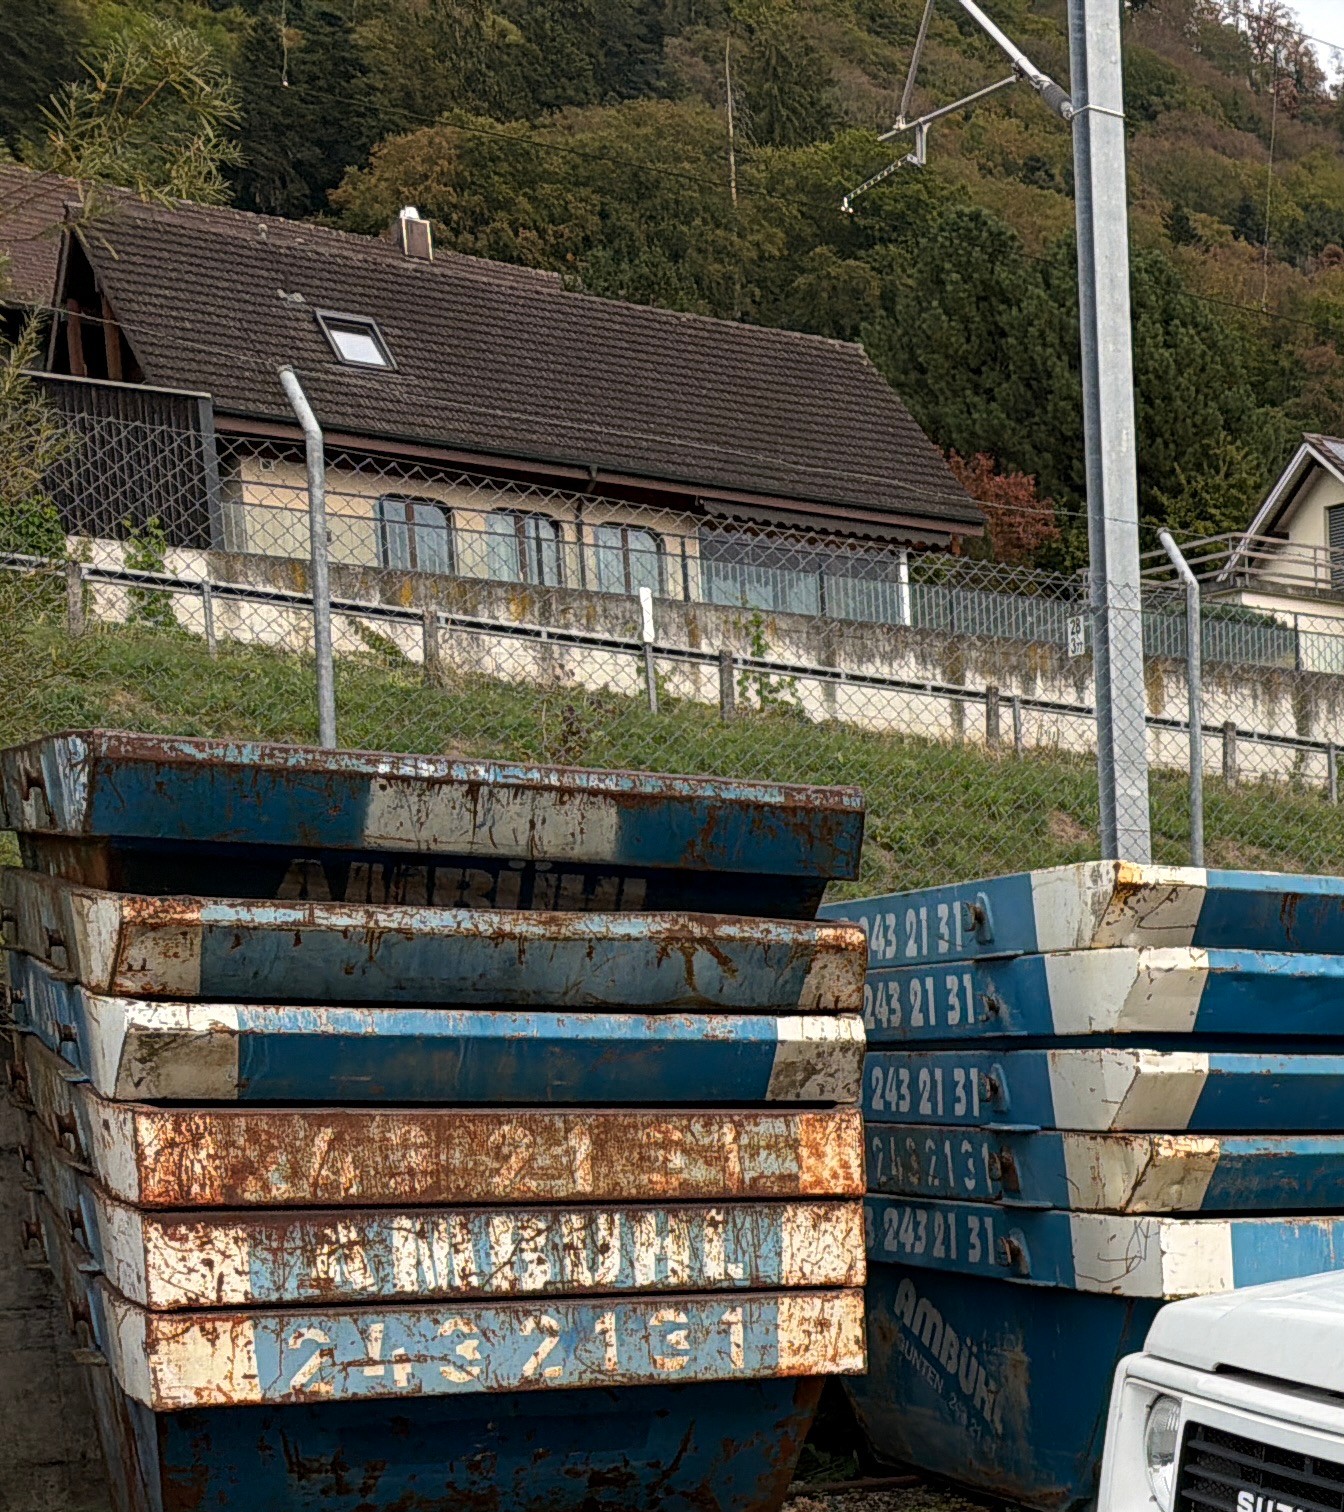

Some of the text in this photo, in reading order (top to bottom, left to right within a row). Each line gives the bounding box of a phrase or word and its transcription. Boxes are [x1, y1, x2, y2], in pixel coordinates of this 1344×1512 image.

[905, 906, 928, 958] 21
[937, 901, 963, 954] 31
[864, 973, 975, 1030] 243 21 31
[871, 1066, 980, 1117] 243 21 31
[925, 1137, 955, 1188] 21
[961, 1139, 993, 1194] 31
[883, 1207, 928, 1254] 243
[933, 1211, 957, 1260] 21
[967, 1215, 995, 1265] 31
